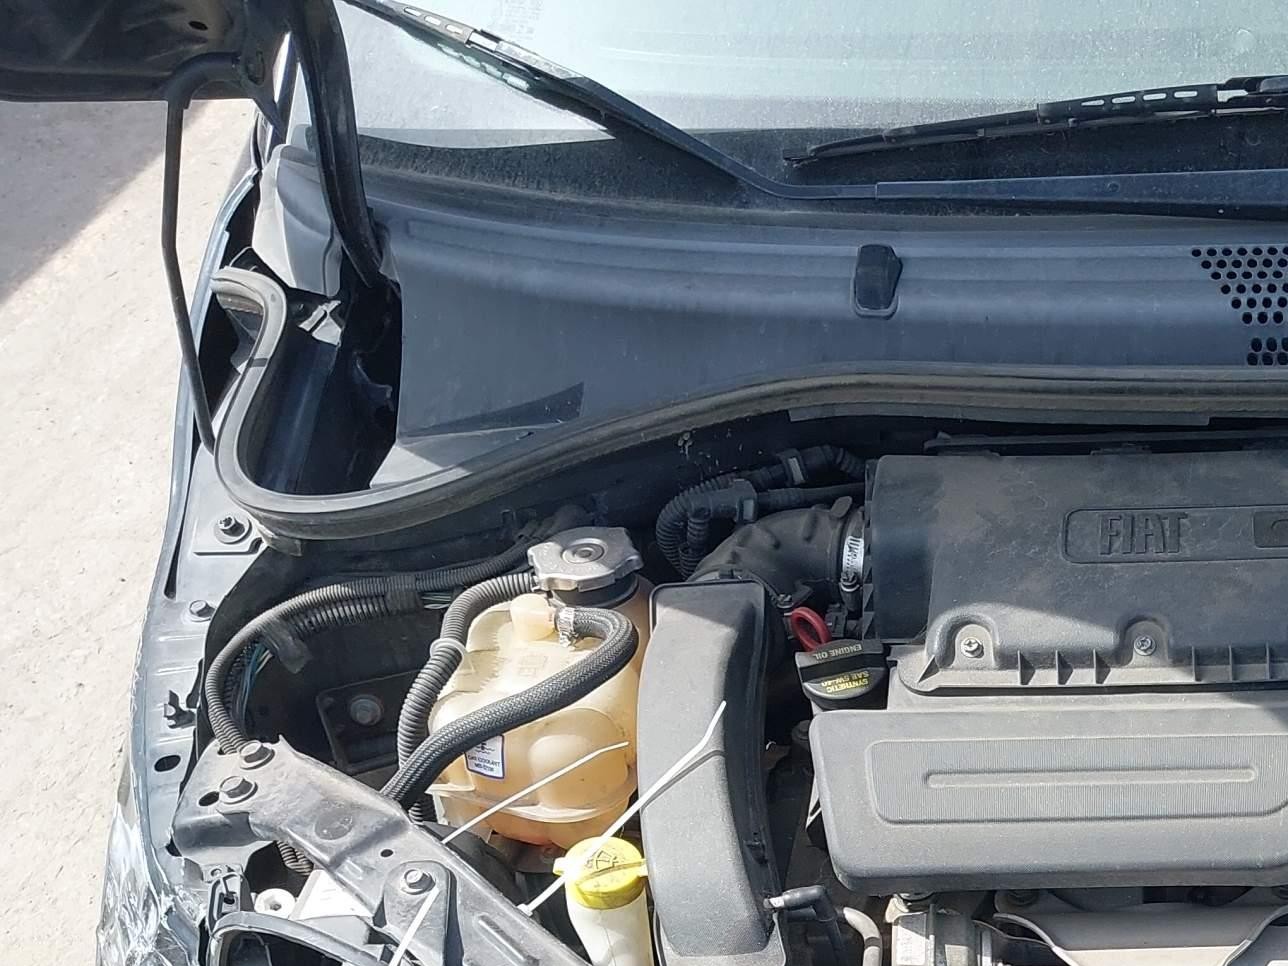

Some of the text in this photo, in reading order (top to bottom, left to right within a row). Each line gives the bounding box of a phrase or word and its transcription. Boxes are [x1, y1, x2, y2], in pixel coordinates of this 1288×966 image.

[1099, 511, 1189, 556] FIAT
[813, 644, 863, 660] ENGINE OIL
[825, 678, 869, 694] SYNTHETIC
